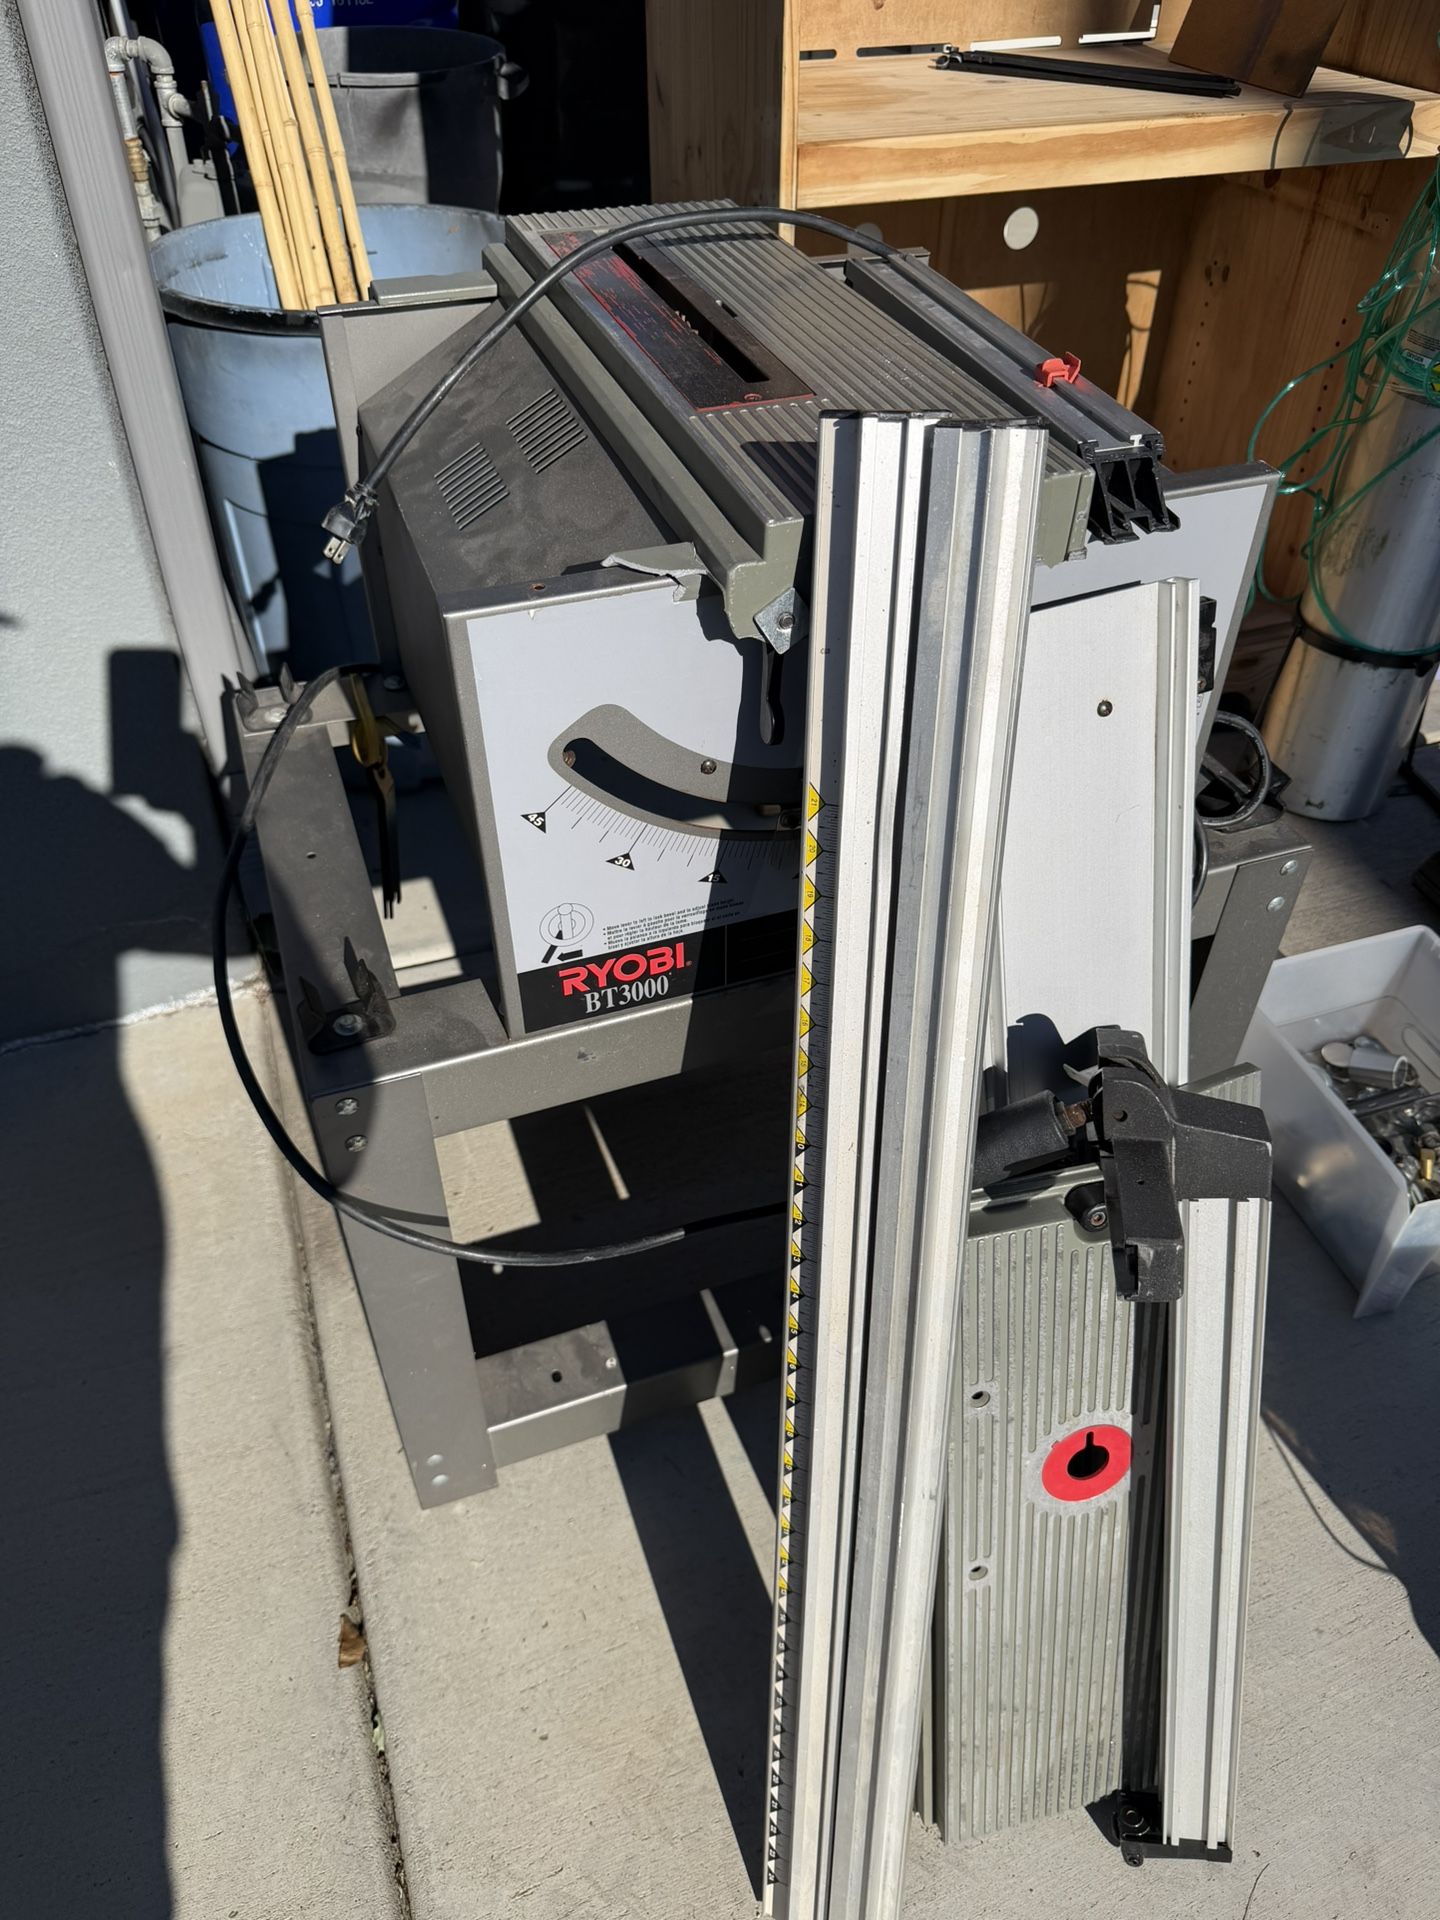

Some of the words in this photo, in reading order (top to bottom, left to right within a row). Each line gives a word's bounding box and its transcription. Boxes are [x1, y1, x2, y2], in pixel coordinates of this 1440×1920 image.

[527, 813, 545, 827] 45
[614, 856, 631, 868] 30
[707, 873, 720, 882] 15
[558, 942, 685, 996] RYOBI
[584, 975, 669, 1014] BT3000
